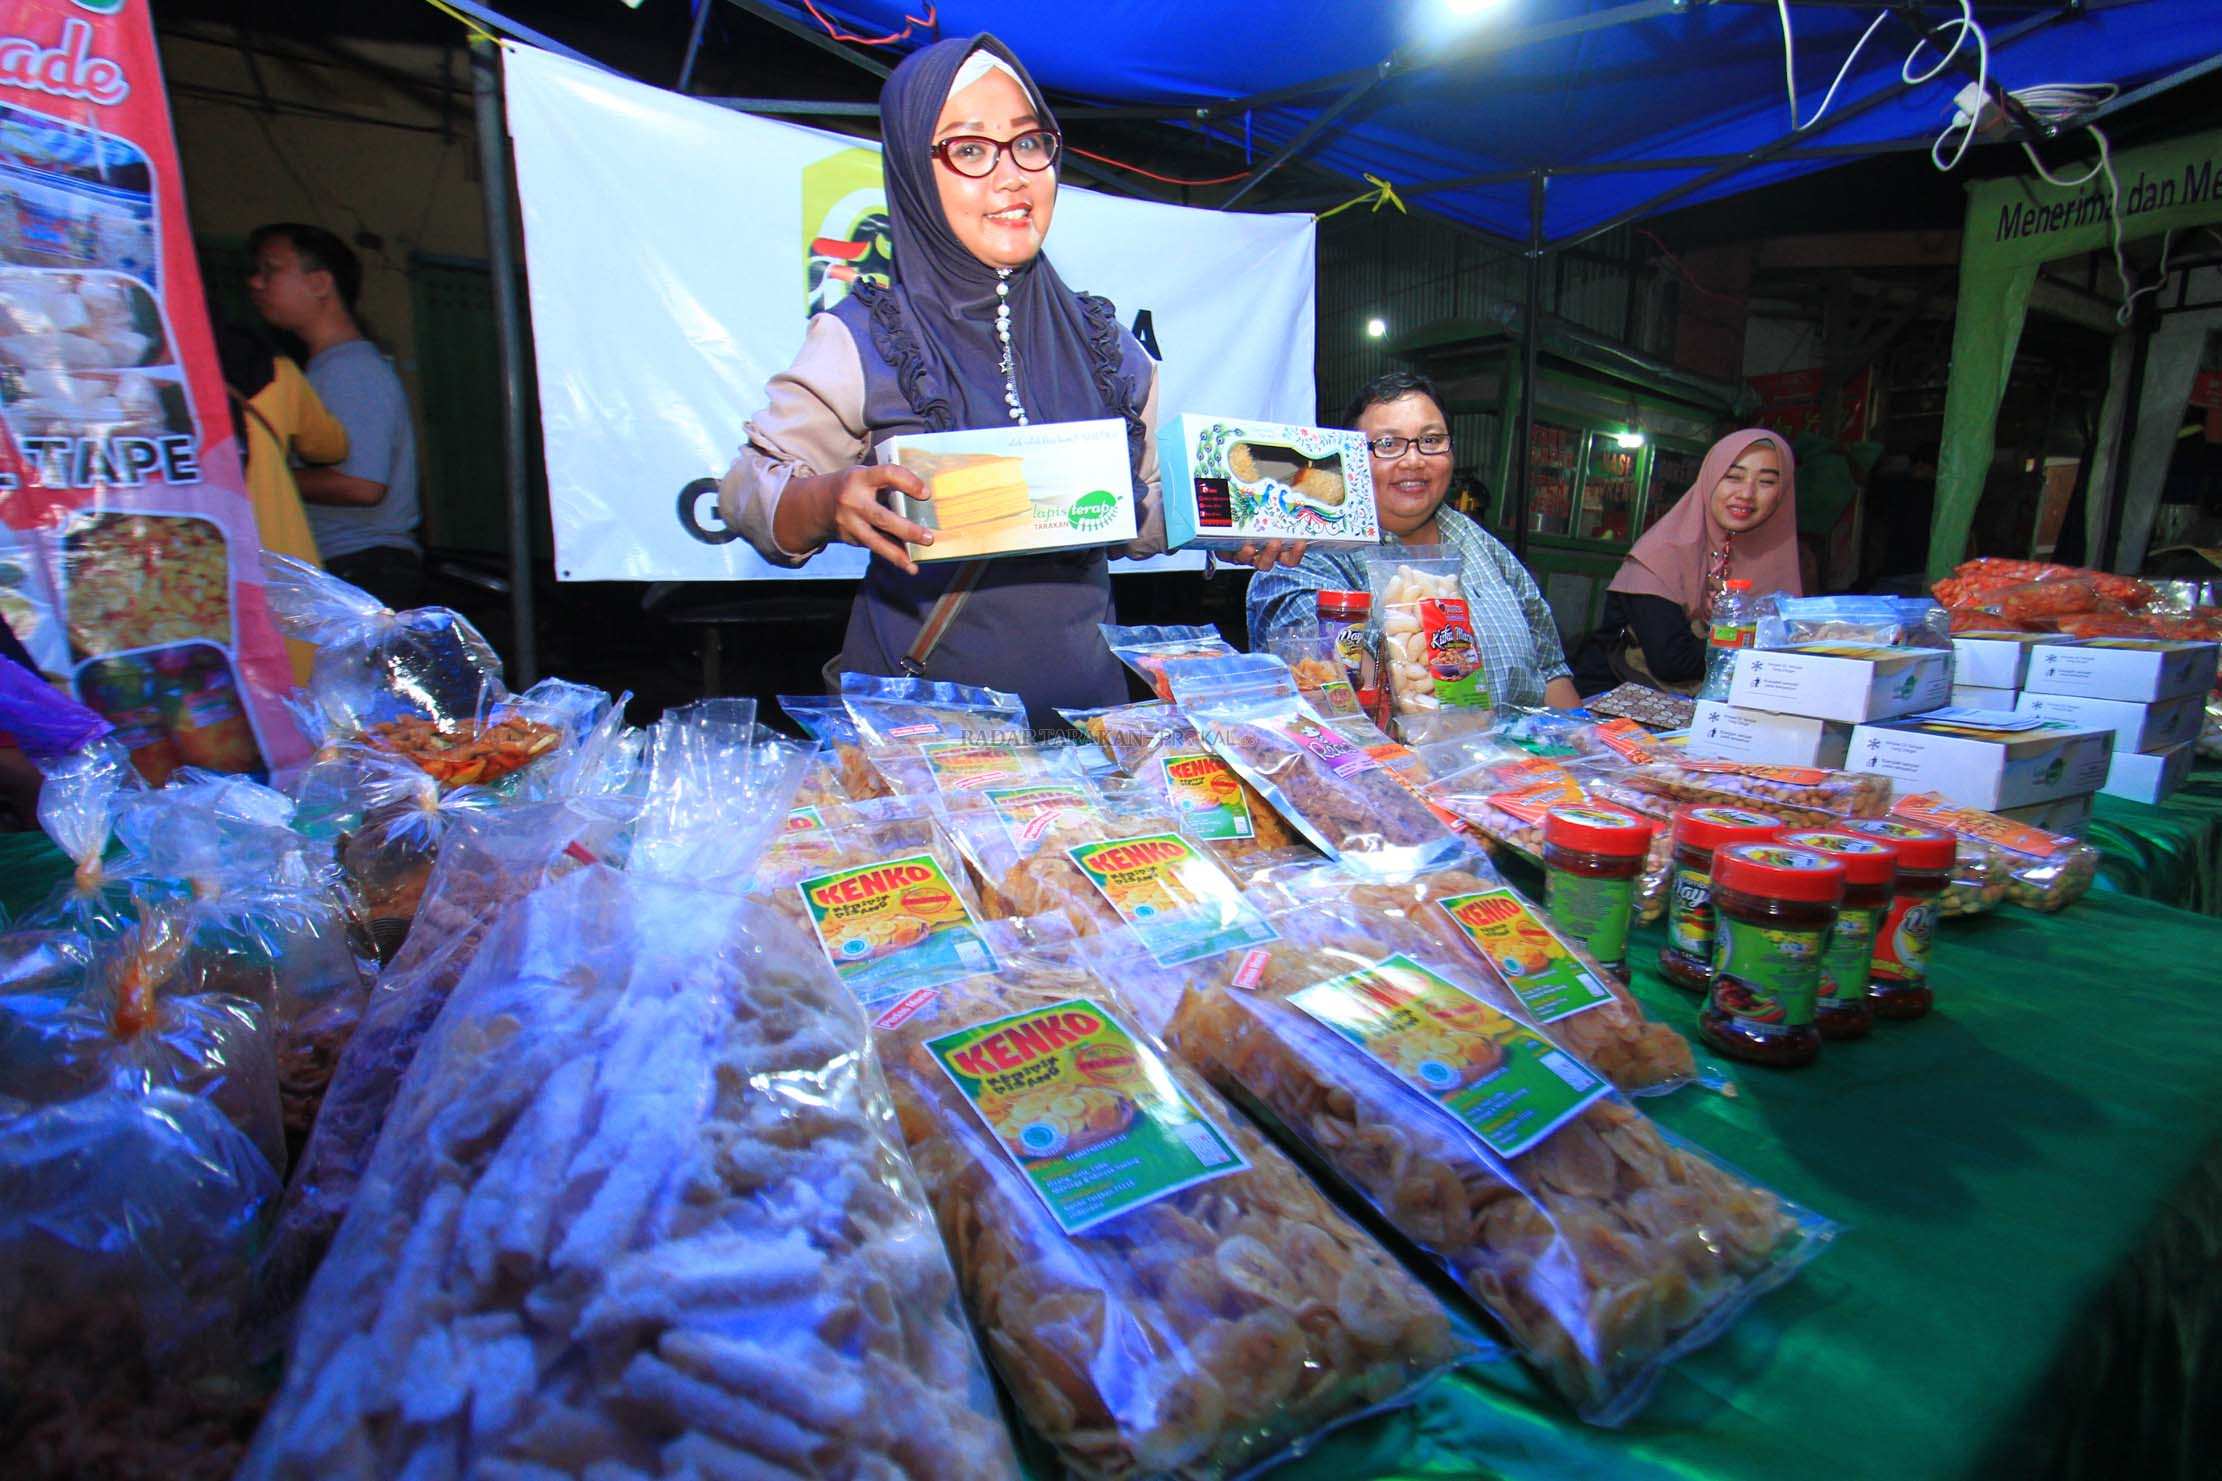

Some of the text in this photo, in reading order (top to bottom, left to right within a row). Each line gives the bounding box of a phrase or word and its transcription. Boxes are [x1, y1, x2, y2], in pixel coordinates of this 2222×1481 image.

[1995, 187, 2115, 242] Menerima
[2126, 171, 2176, 217] dan
[1088, 841, 1186, 871] KENKO
[816, 865, 932, 906] KENKO
[1455, 898, 1521, 926] KENKO
[953, 1012, 1101, 1075] KENKO
